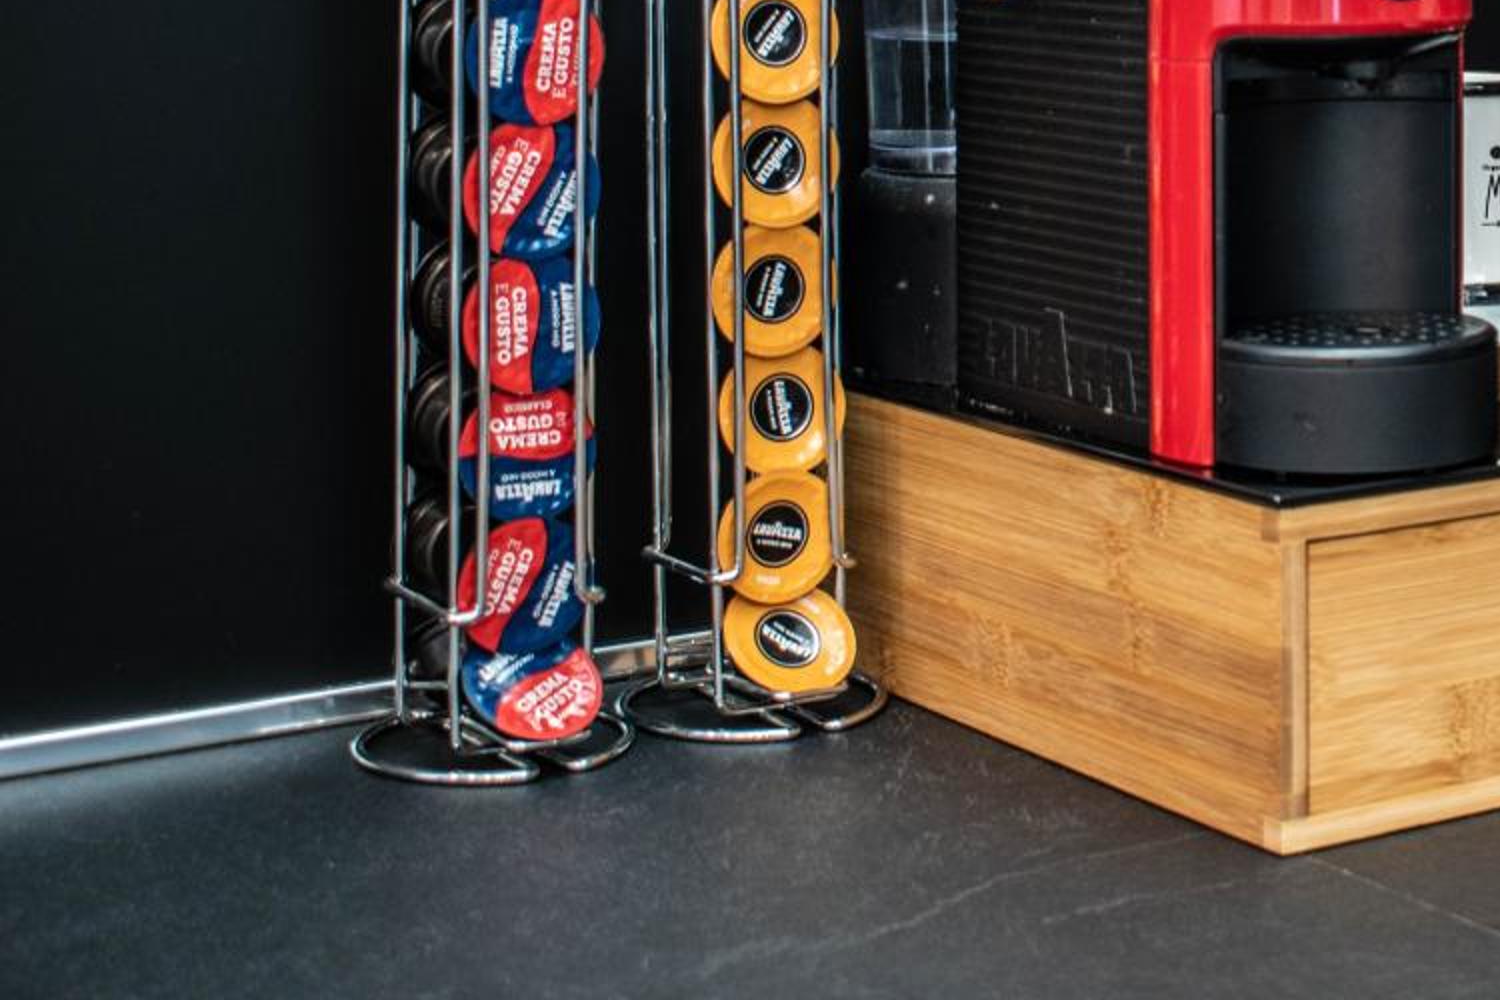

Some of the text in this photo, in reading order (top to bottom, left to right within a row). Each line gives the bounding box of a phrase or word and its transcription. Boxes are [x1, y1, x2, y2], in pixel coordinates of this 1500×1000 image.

[536, 22, 558, 93] CREMA
[554, 17, 574, 85] GUSTO
[514, 137, 529, 151] E
[499, 150, 541, 215] CREMA
[495, 283, 512, 365] E GUSTO
[511, 286, 529, 359] CREMA
[489, 414, 553, 434] GUSTO
[495, 430, 562, 450] CREMA
[497, 548, 533, 614] CREMA
